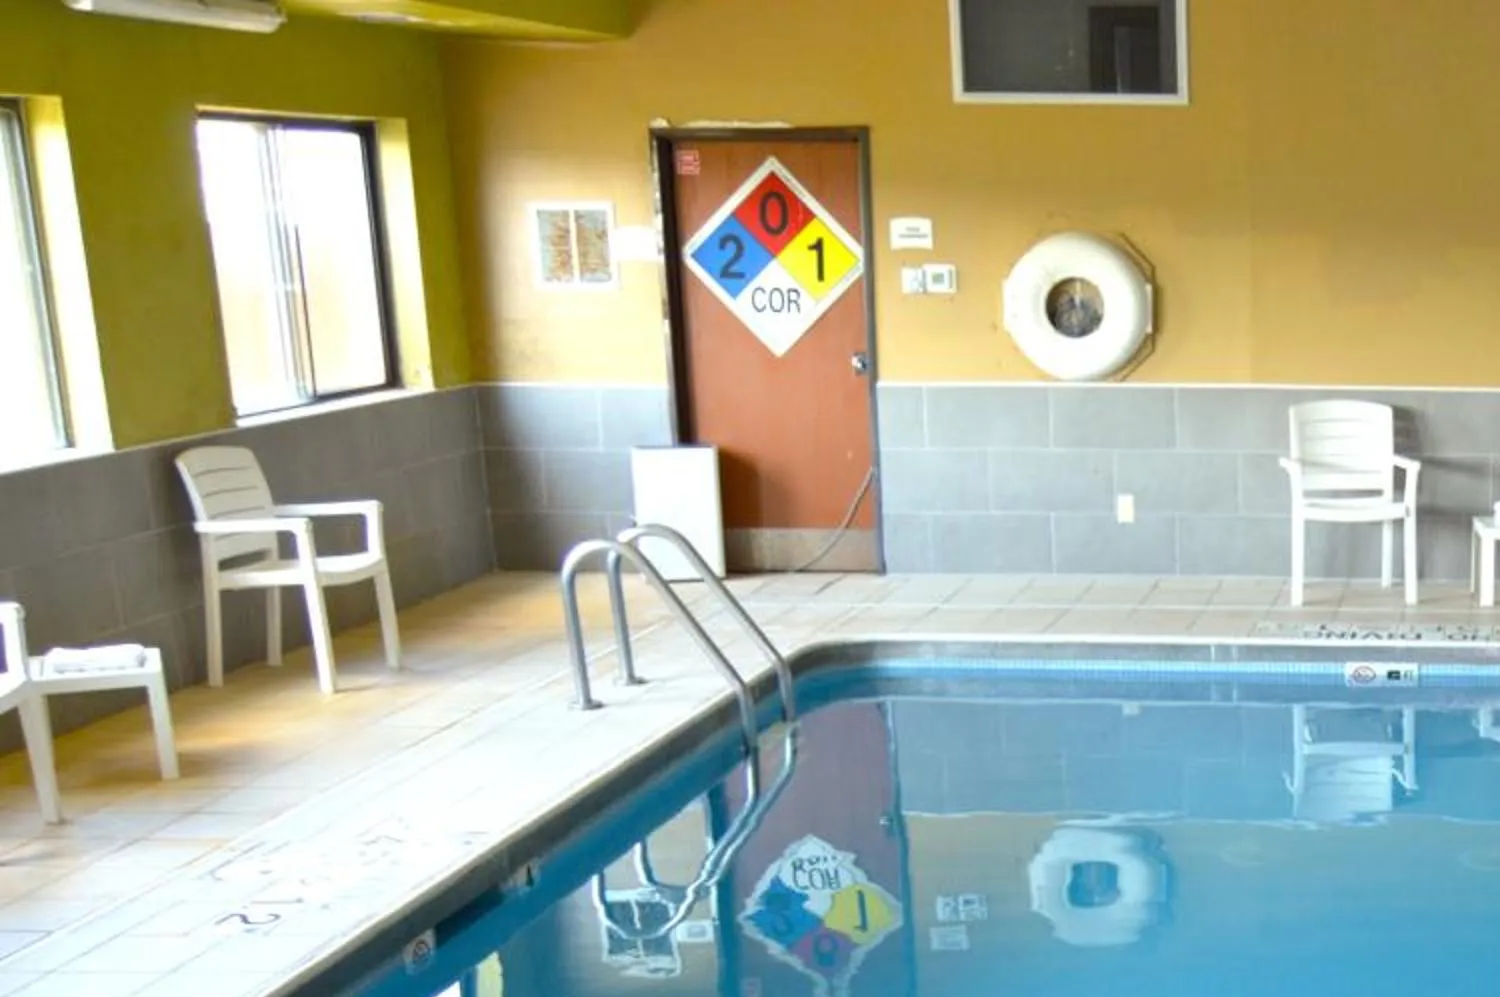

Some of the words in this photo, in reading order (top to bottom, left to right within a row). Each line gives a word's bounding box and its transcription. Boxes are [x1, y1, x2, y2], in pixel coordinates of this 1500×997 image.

[759, 191, 789, 236] 0
[718, 233, 746, 279] 2
[807, 237, 825, 282] 1
[751, 287, 801, 313] COR
